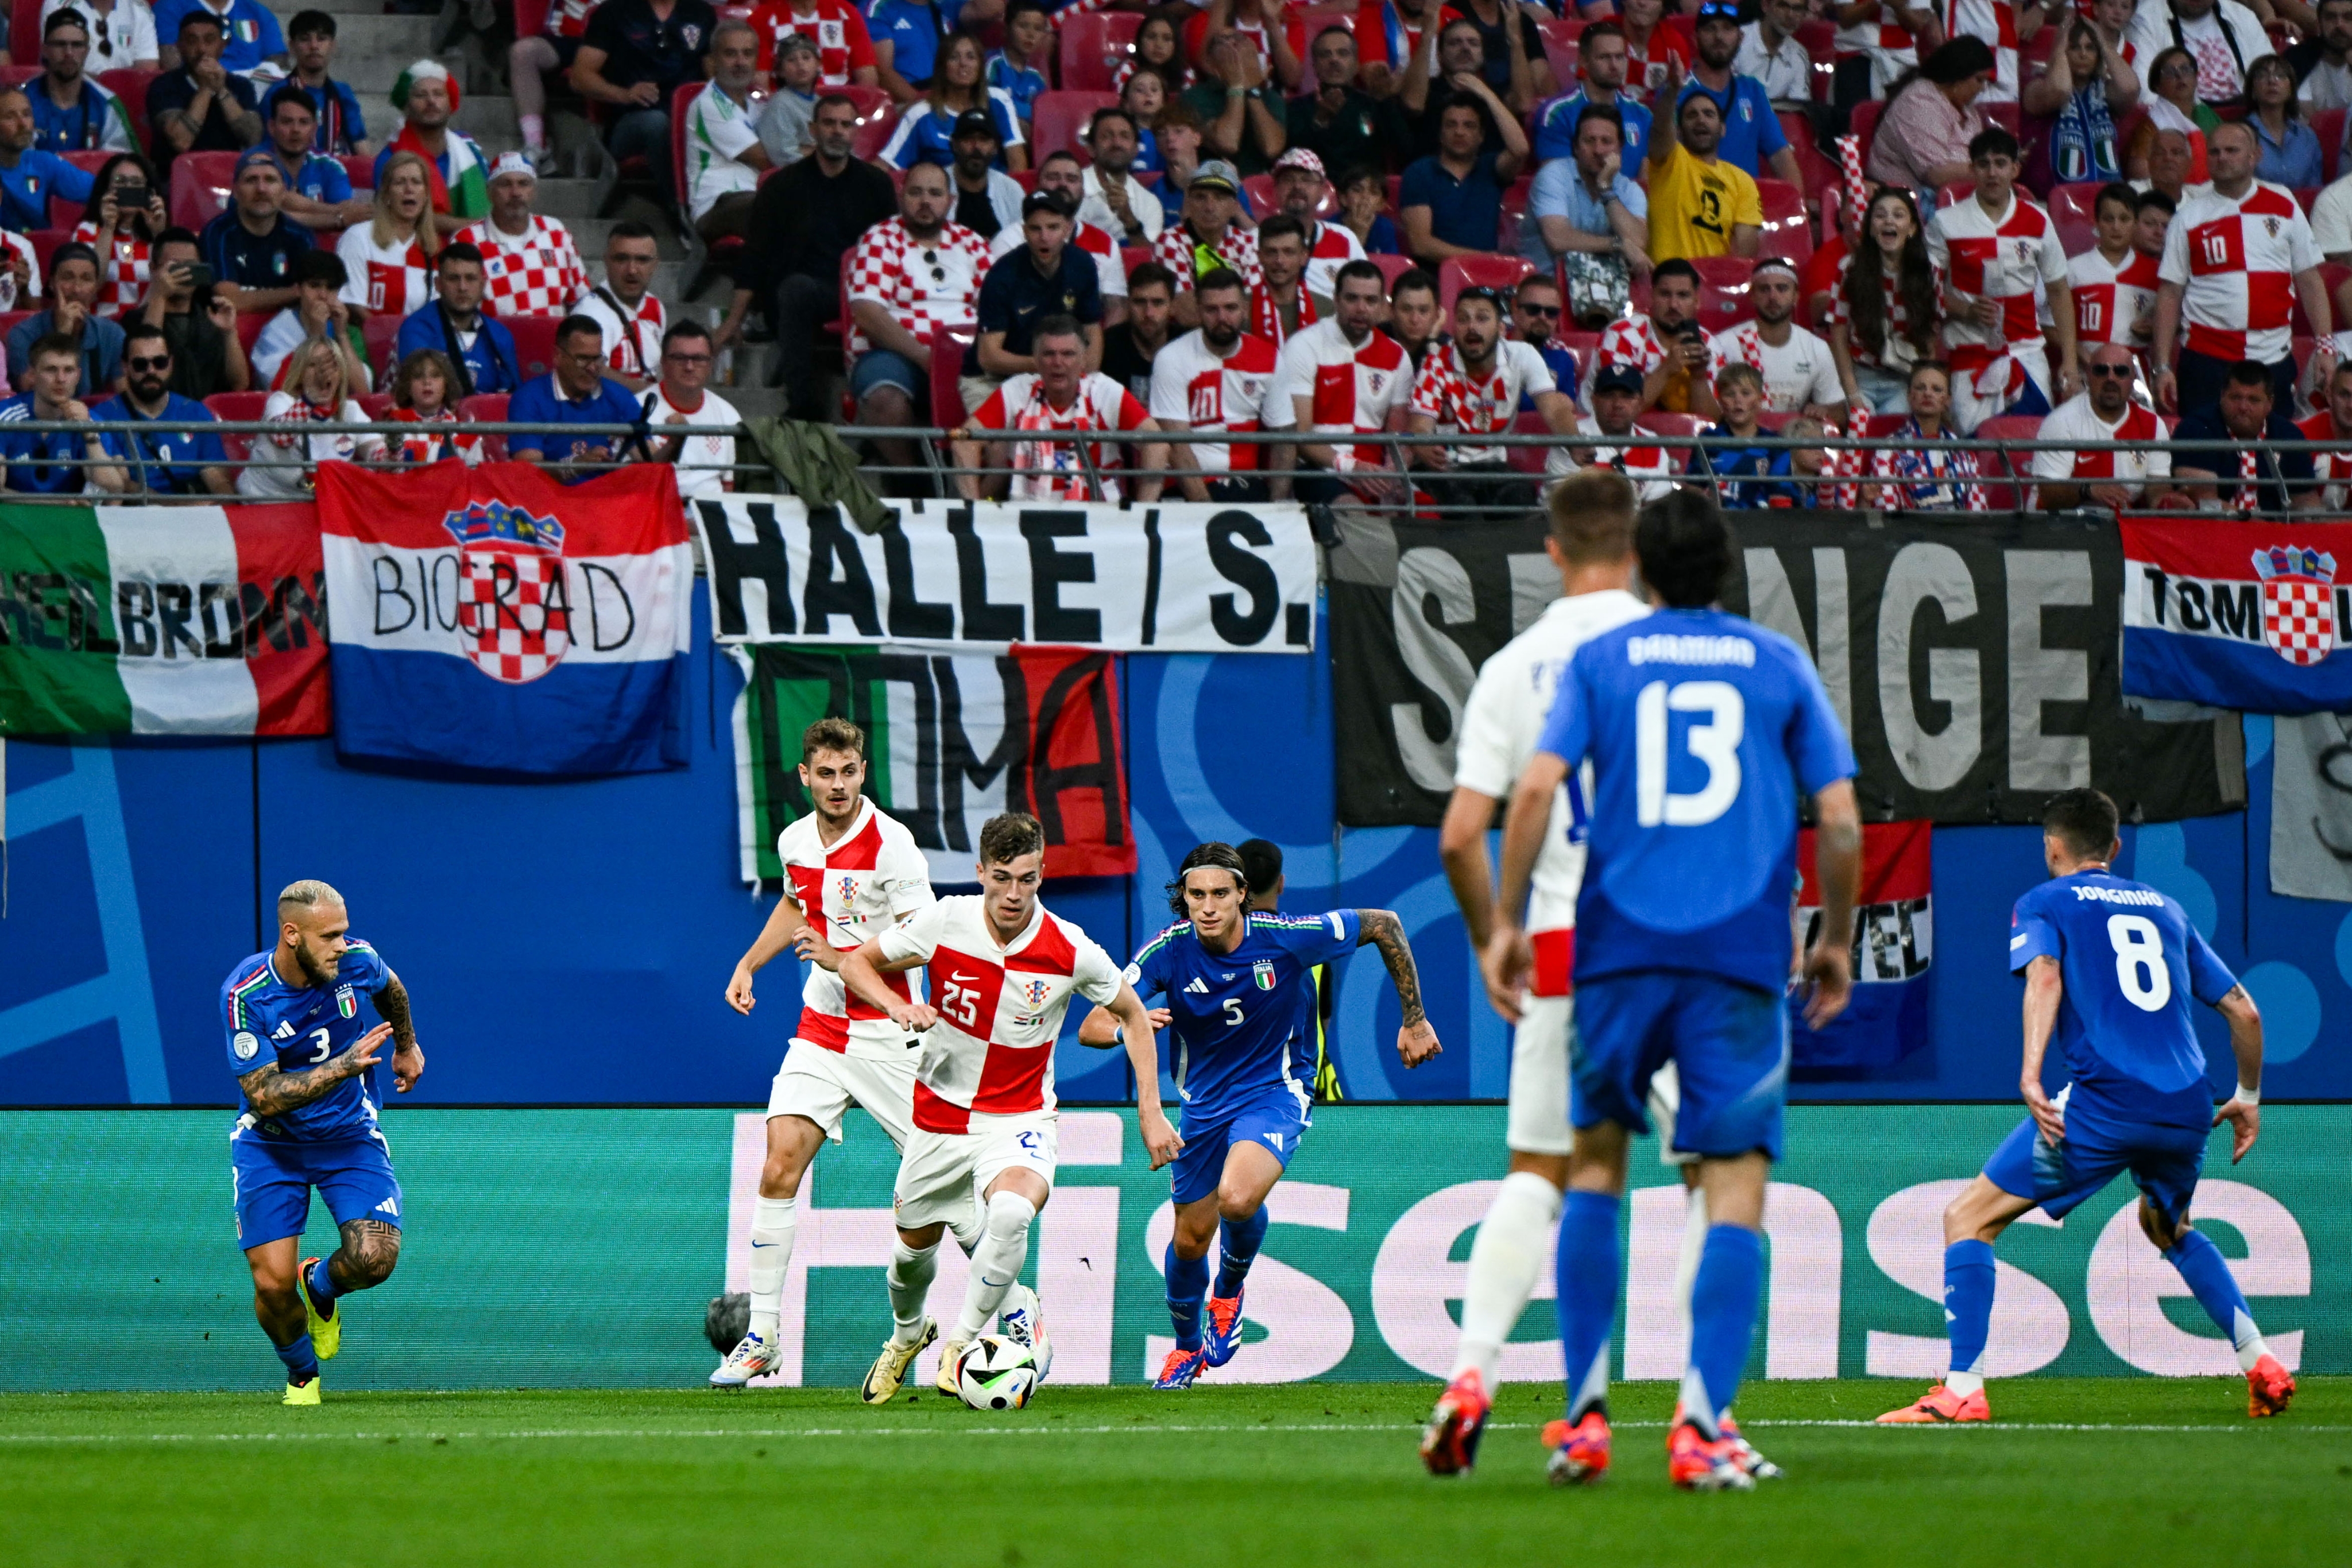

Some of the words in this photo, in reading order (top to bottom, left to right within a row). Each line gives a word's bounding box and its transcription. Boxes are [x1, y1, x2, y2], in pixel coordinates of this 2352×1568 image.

[2202, 235, 2227, 265] 10
[2080, 302, 2102, 331] 10
[1191, 386, 1216, 421] 10
[694, 499, 1101, 642] HALLE
[1141, 509, 1162, 645] /
[1206, 509, 1309, 647] S.
[374, 554, 636, 651] BIOGRAD
[1627, 633, 1757, 669] DARMIAN
[758, 648, 1123, 853] ROMA
[1636, 680, 1745, 828] 13
[2071, 886, 2165, 907] JORGINHO
[1255, 965, 1272, 973] ITALIA
[2107, 913, 2171, 1012] 8
[339, 989, 352, 1000] ITALIA
[942, 980, 981, 1028] 25
[1223, 998, 1244, 1025] 5
[309, 1027, 330, 1063] 3
[723, 1112, 2311, 1385] Hisense
